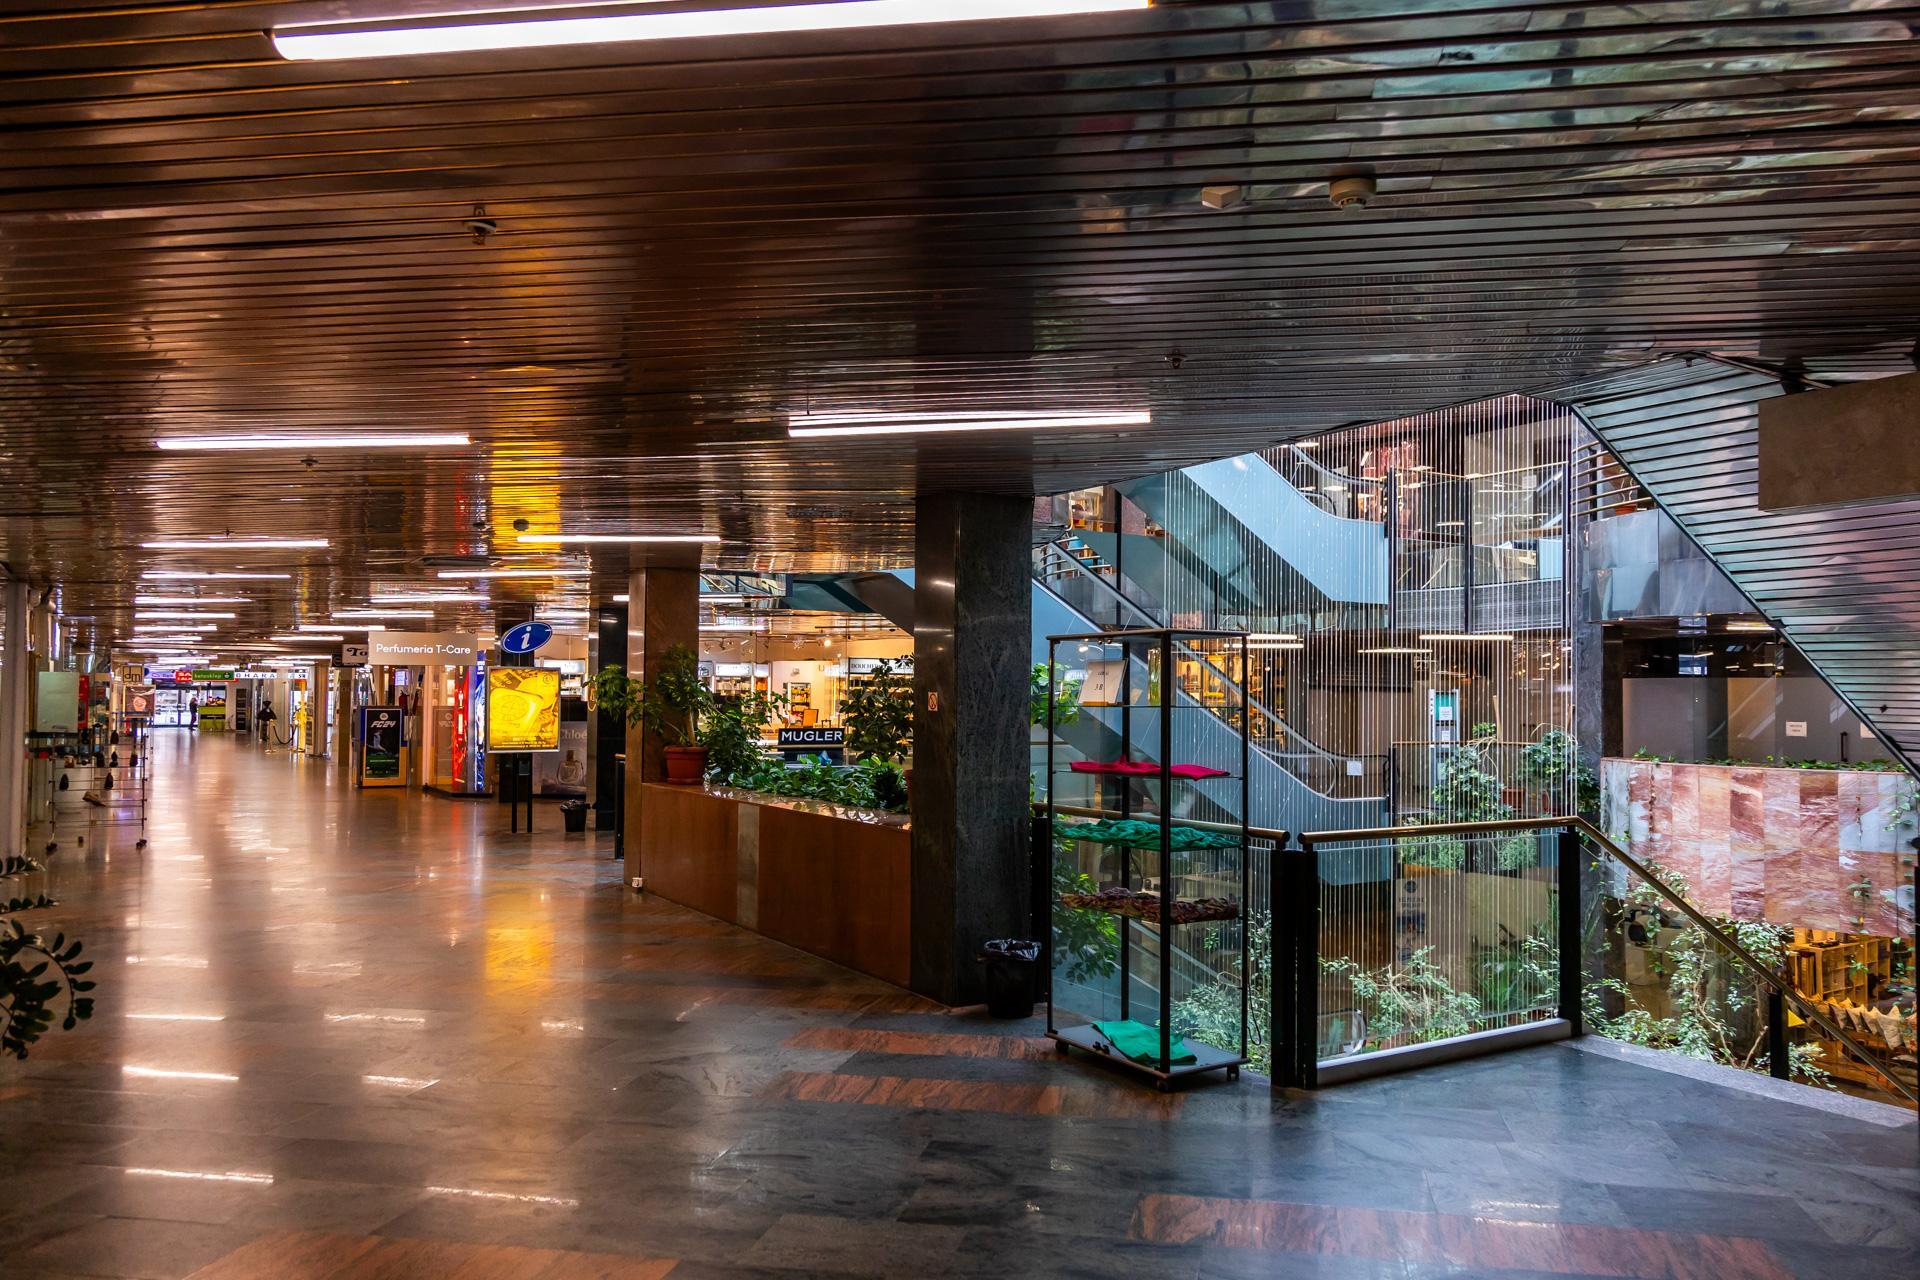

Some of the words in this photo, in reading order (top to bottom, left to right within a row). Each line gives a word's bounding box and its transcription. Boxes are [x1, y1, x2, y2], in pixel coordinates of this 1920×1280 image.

[376, 644, 433, 654] Perfumeria
[436, 644, 471, 654] T-Care
[124, 666, 141, 682] dm
[781, 731, 843, 742] MUGLER
